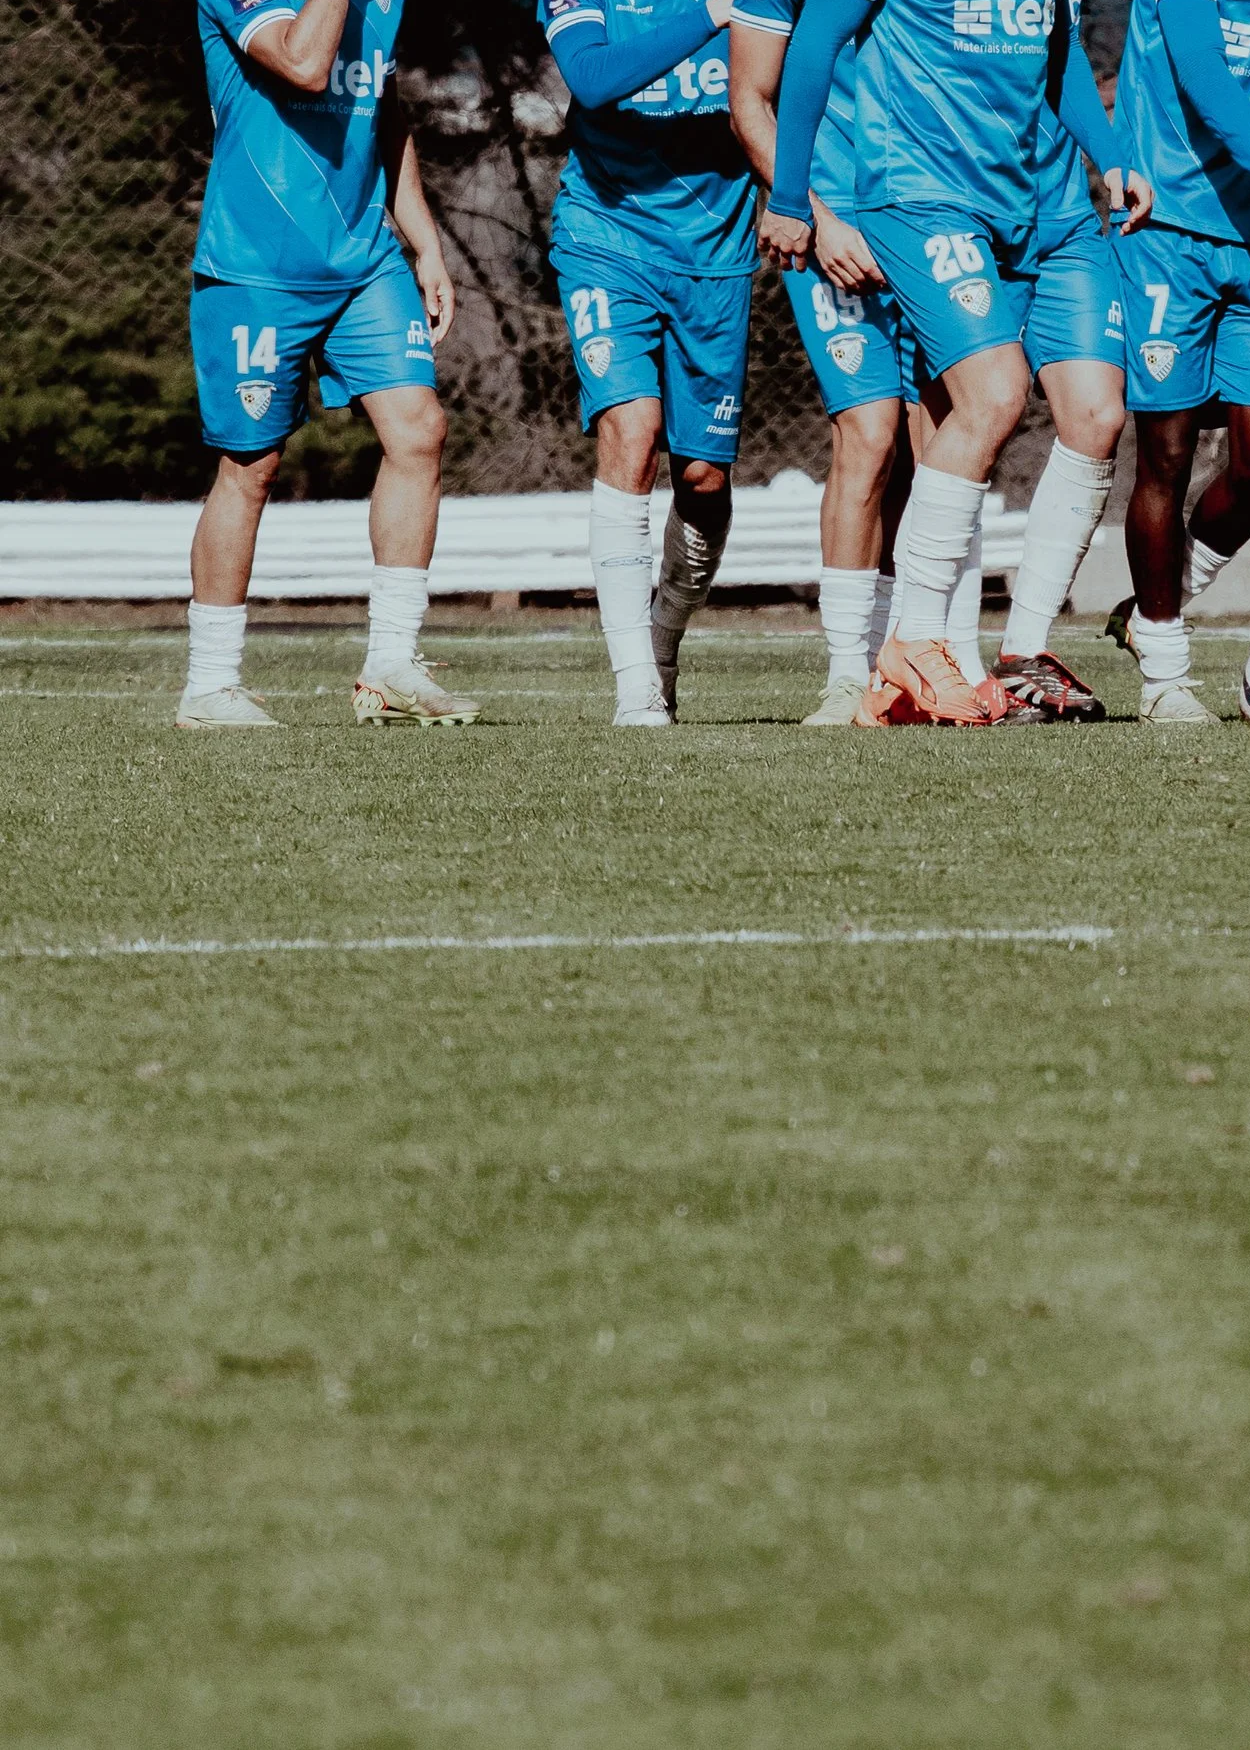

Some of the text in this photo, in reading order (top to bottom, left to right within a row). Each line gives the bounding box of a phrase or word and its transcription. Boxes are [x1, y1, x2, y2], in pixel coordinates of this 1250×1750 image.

[953, 39, 1000, 54] Materiais
[1002, 41, 1013, 54] de
[673, 56, 729, 101] te
[923, 232, 985, 284] 26
[569, 286, 612, 340] 21
[1145, 284, 1170, 335] 7
[231, 324, 280, 374] 14
